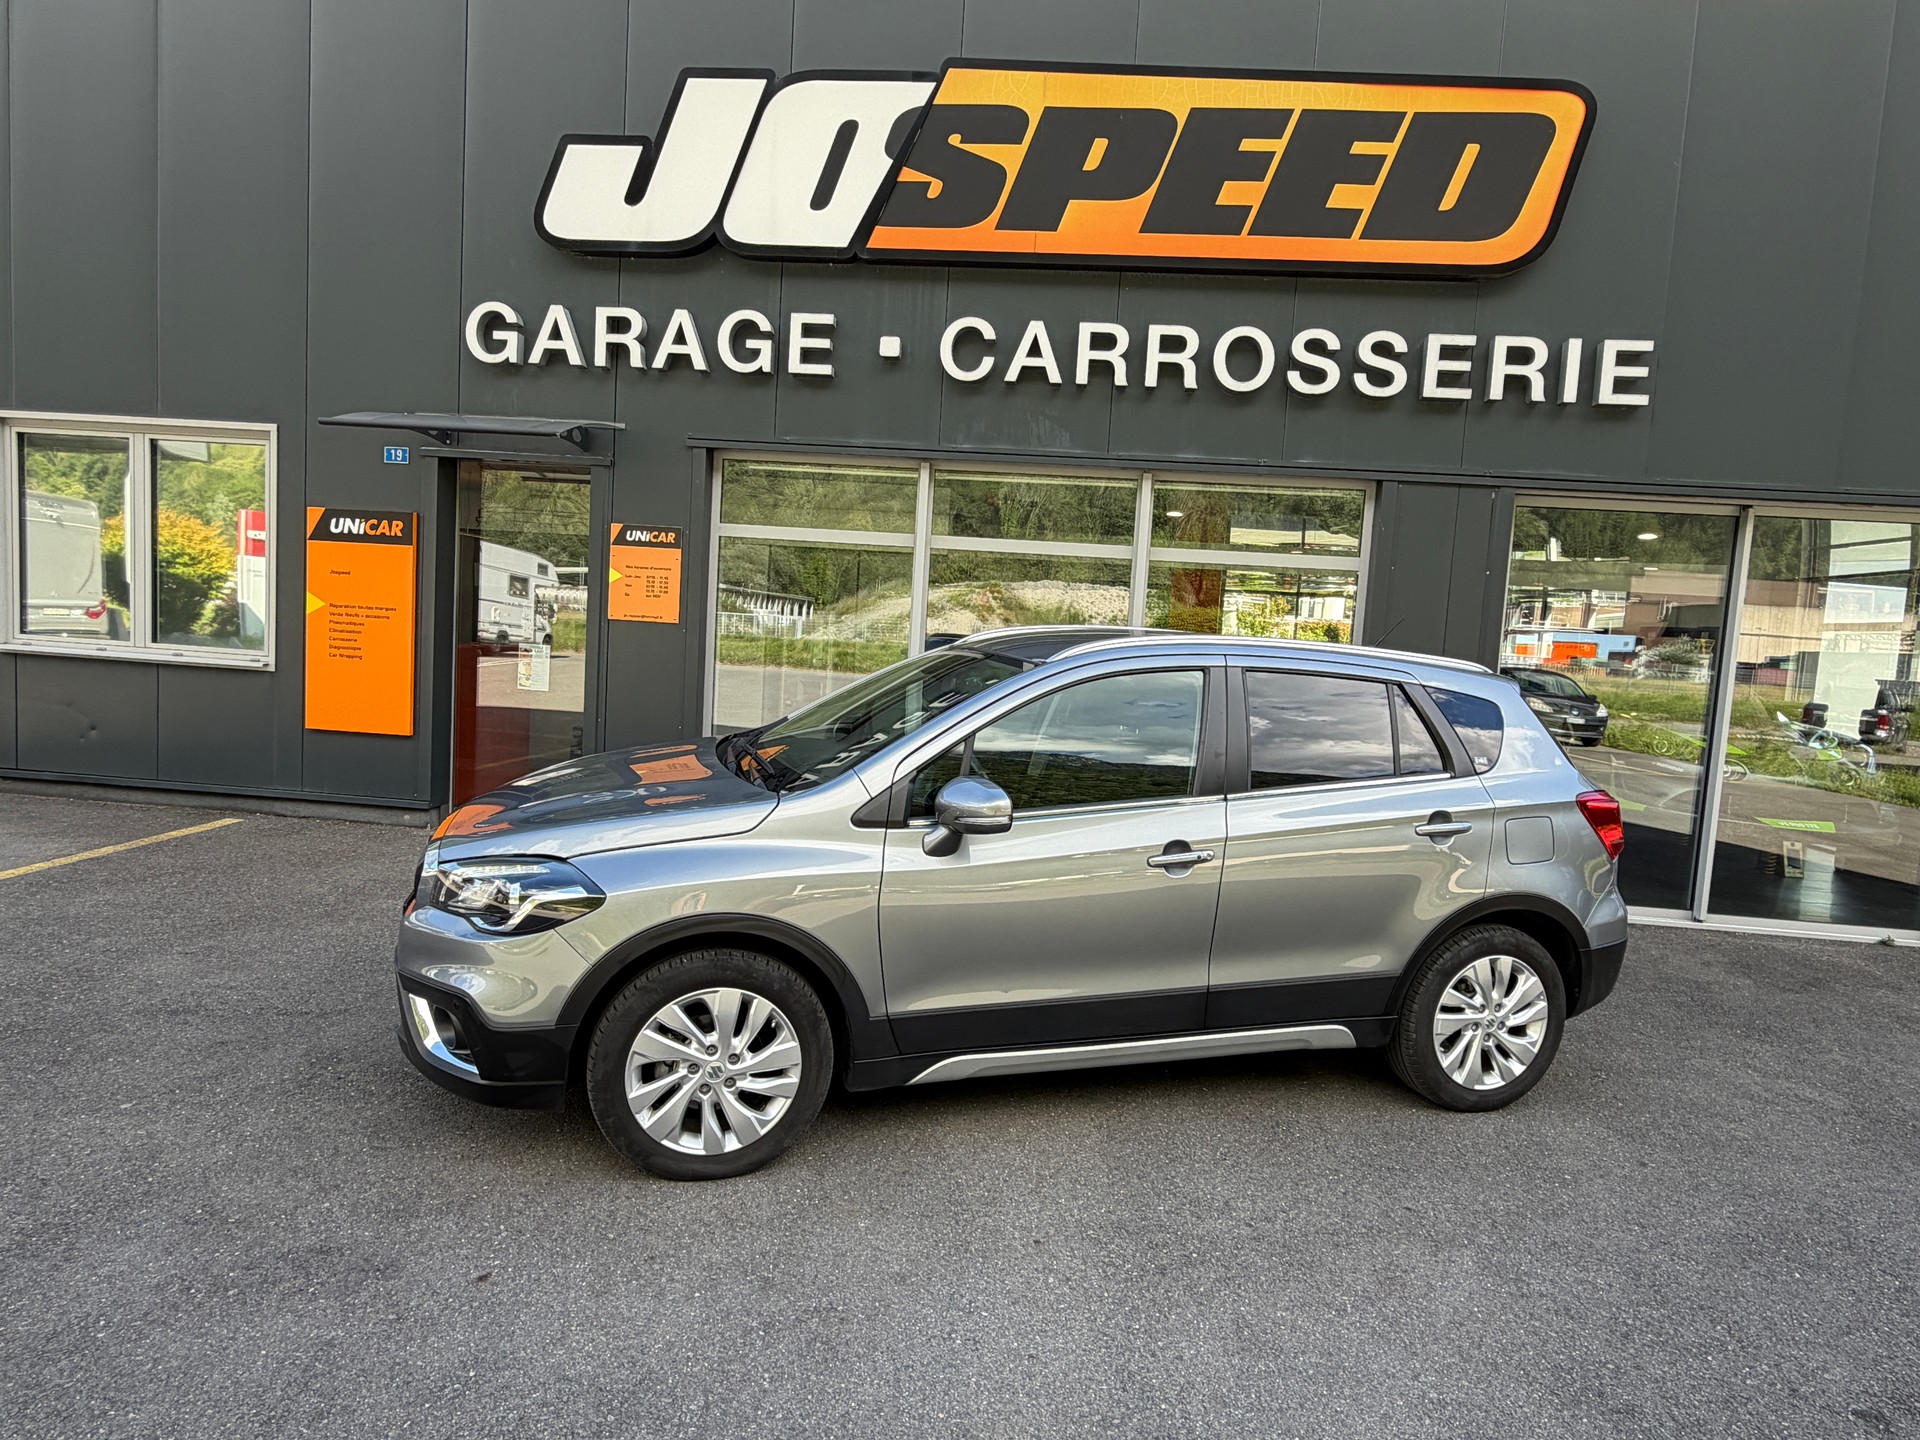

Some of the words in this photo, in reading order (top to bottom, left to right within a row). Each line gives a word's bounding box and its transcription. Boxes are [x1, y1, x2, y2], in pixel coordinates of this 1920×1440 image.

[465, 301, 837, 378] GARAGE
[940, 316, 1655, 407] CARROSSERIE
[390, 449, 403, 461] 19
